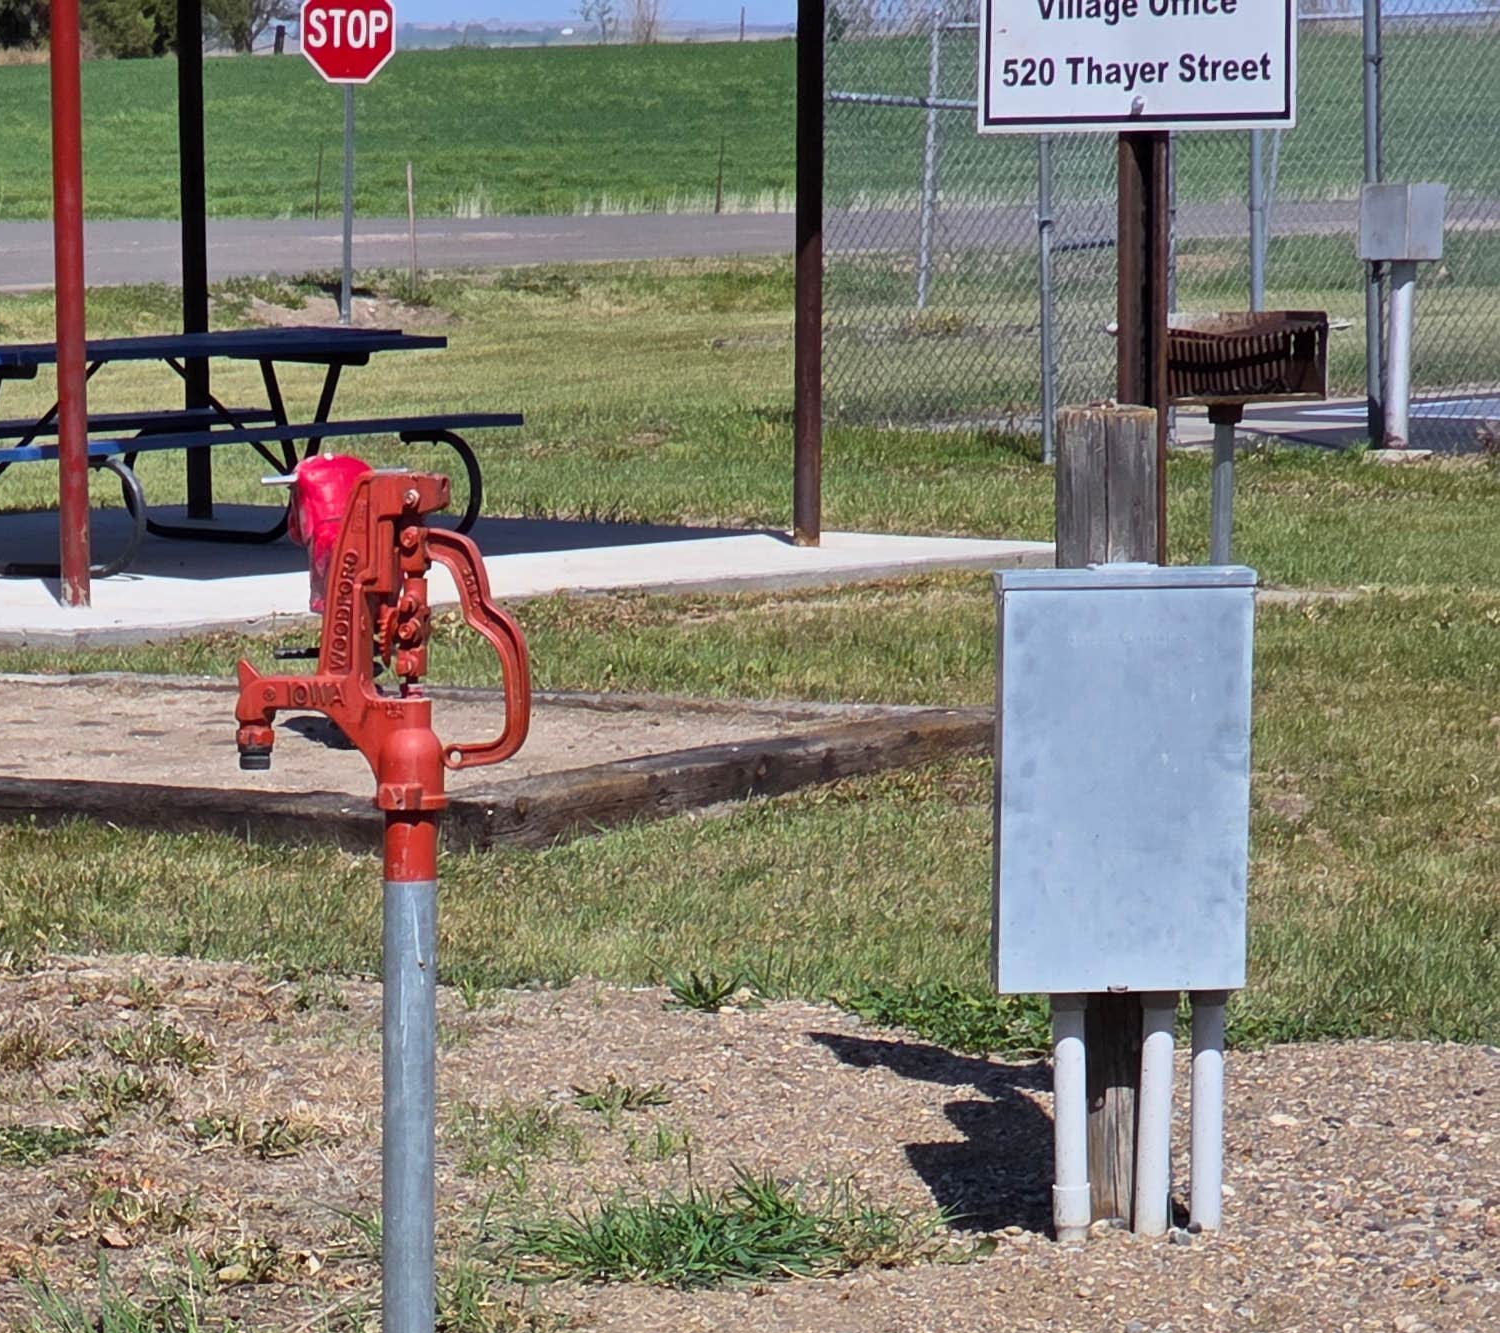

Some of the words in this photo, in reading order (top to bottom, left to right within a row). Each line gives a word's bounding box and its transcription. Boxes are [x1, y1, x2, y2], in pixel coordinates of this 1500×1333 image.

[308, 8, 388, 48] STOP
[1037, 0, 1138, 26] Village
[1002, 57, 1055, 87] 520
[1066, 56, 1169, 91] Thayer
[1178, 52, 1272, 83] Street
[328, 549, 359, 673] WOODFORD
[287, 680, 345, 708] IOWA
